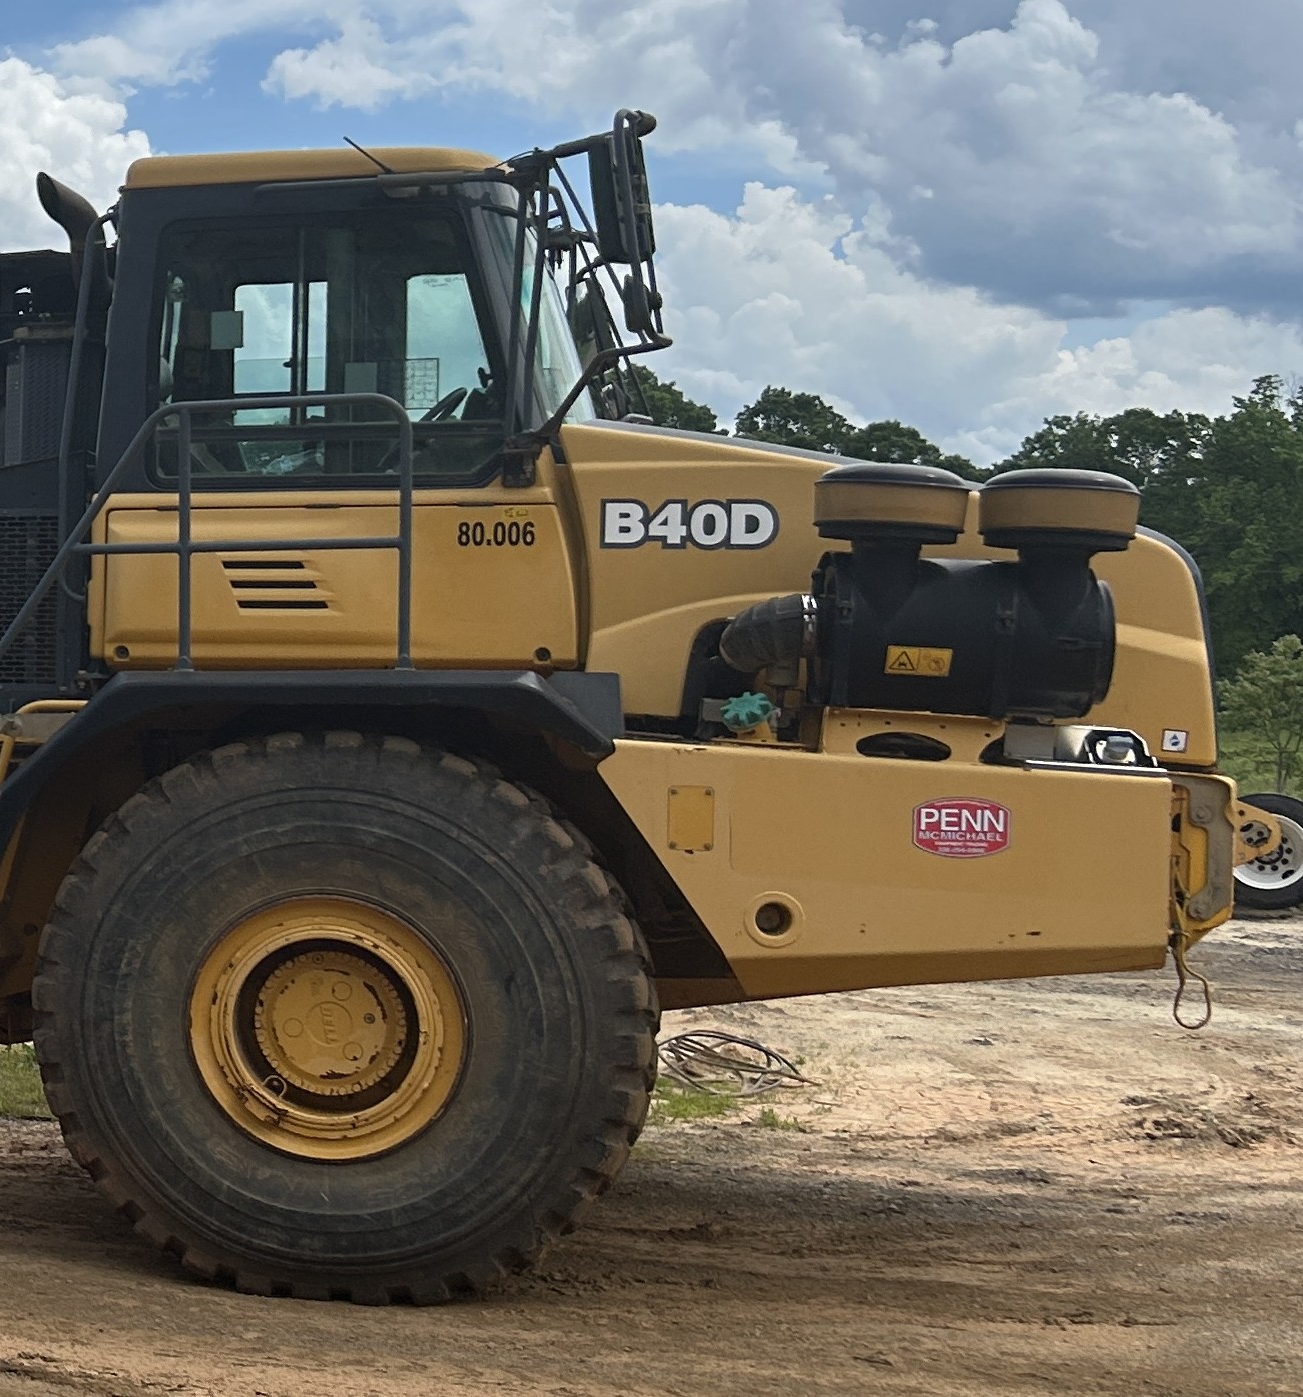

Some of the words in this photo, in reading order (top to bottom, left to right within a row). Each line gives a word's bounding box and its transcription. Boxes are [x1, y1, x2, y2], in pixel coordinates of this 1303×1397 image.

[457, 521, 536, 547] 80.006
[601, 500, 779, 549] B40D
[920, 808, 1005, 833] PENN
[918, 830, 1003, 842] MCMICHAEL
